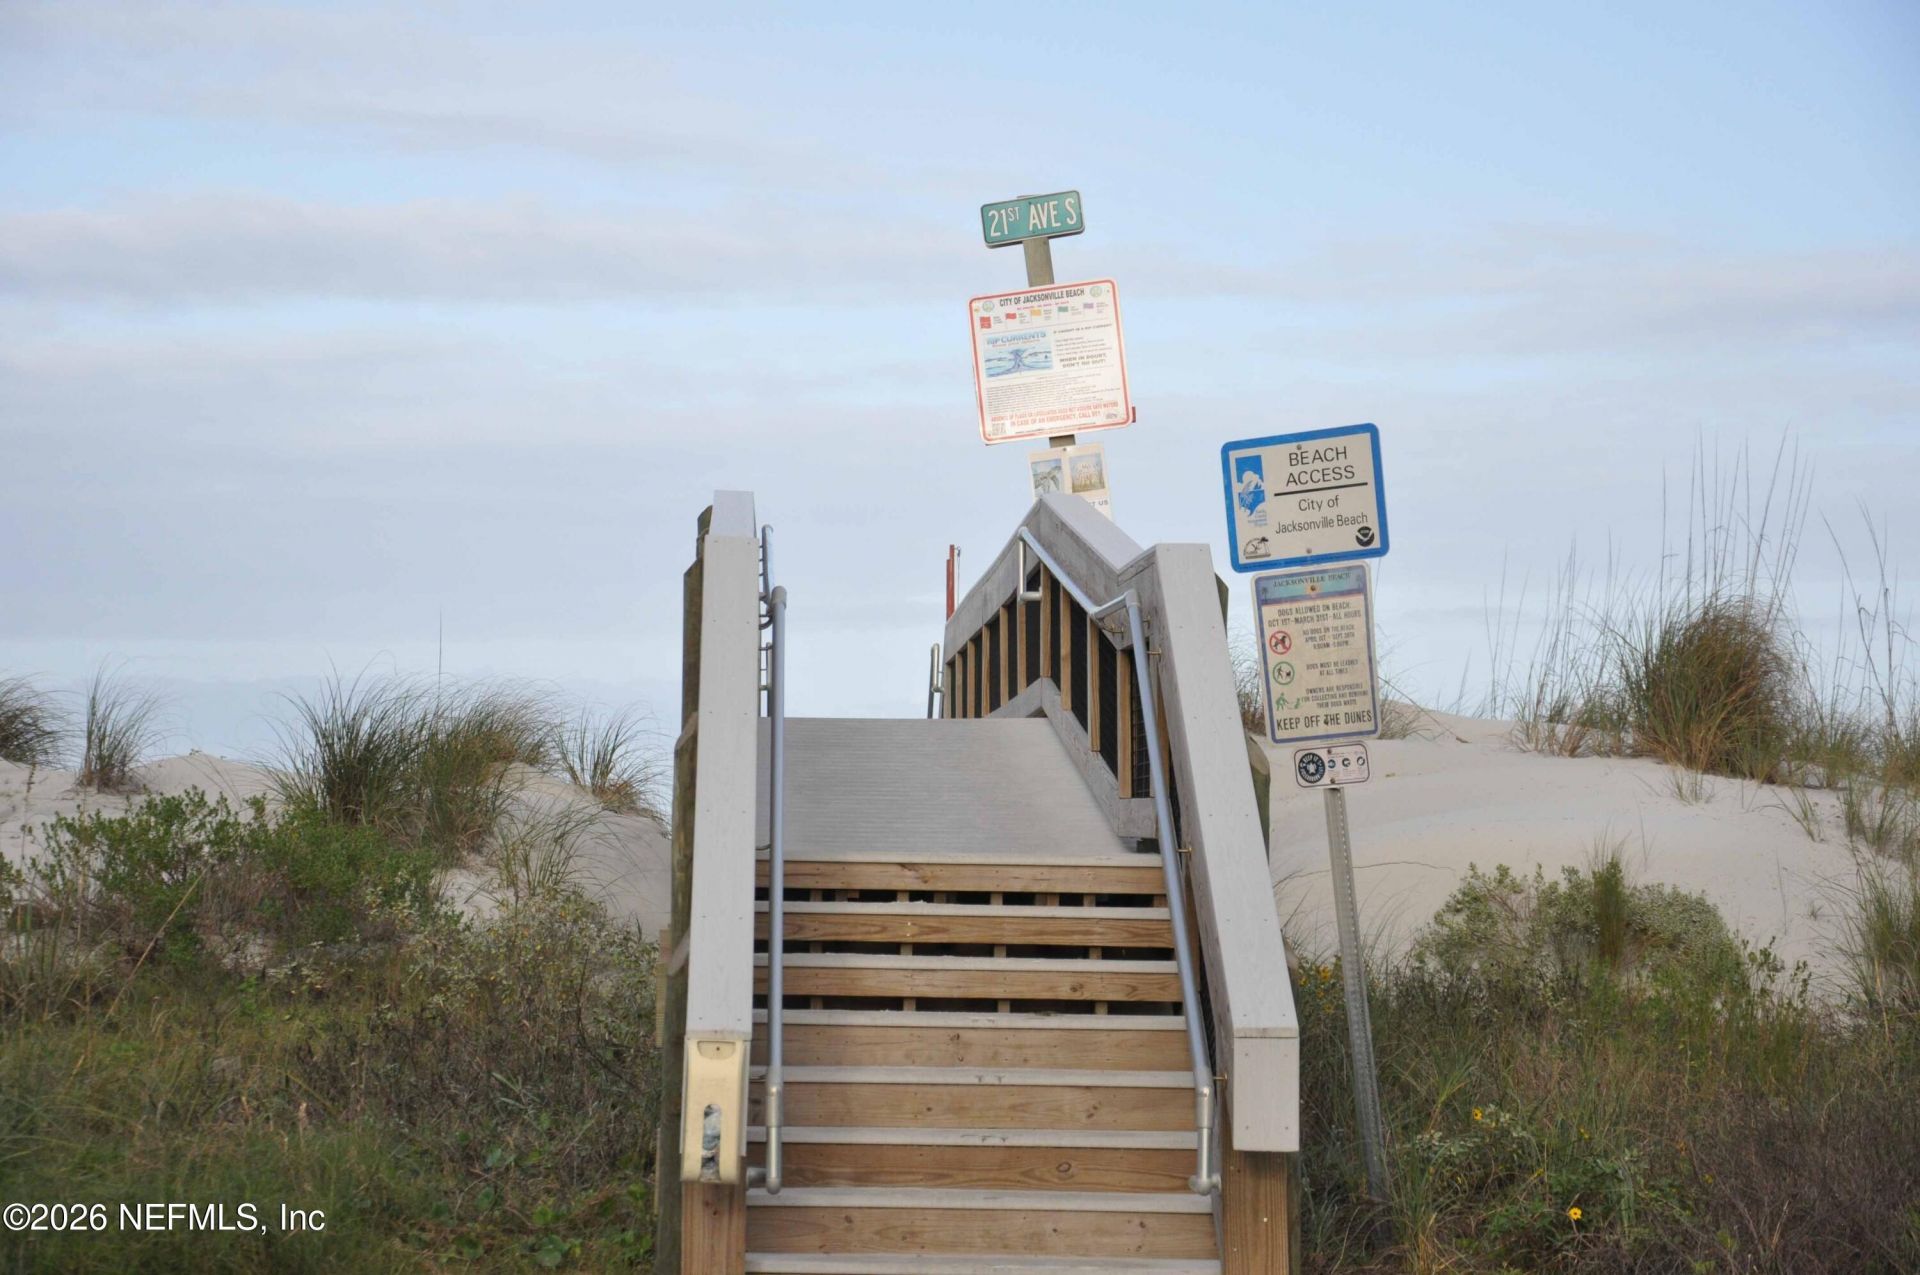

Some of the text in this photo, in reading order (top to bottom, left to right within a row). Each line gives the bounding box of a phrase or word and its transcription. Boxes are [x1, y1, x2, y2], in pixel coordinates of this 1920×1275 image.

[988, 198, 1077, 237] 21ST AVE S
[1000, 297, 1013, 307] CITY
[1014, 296, 1021, 305] OF
[1023, 290, 1064, 304] JACKSONVILLE
[1066, 288, 1085, 299] BEACH
[1288, 446, 1347, 467] BEACH
[1286, 465, 1355, 487] ACCESS
[1298, 495, 1340, 512] City of
[1275, 515, 1334, 534] Jacksonville
[1336, 512, 1368, 527] Beach
[1273, 572, 1352, 588] JACKSONVILLE BEACH
[1277, 607, 1293, 617] DOGS
[1295, 605, 1320, 615] ALLOWED
[1322, 604, 1330, 612] ON
[1276, 710, 1372, 731] KEEP OFF THE DUNES
